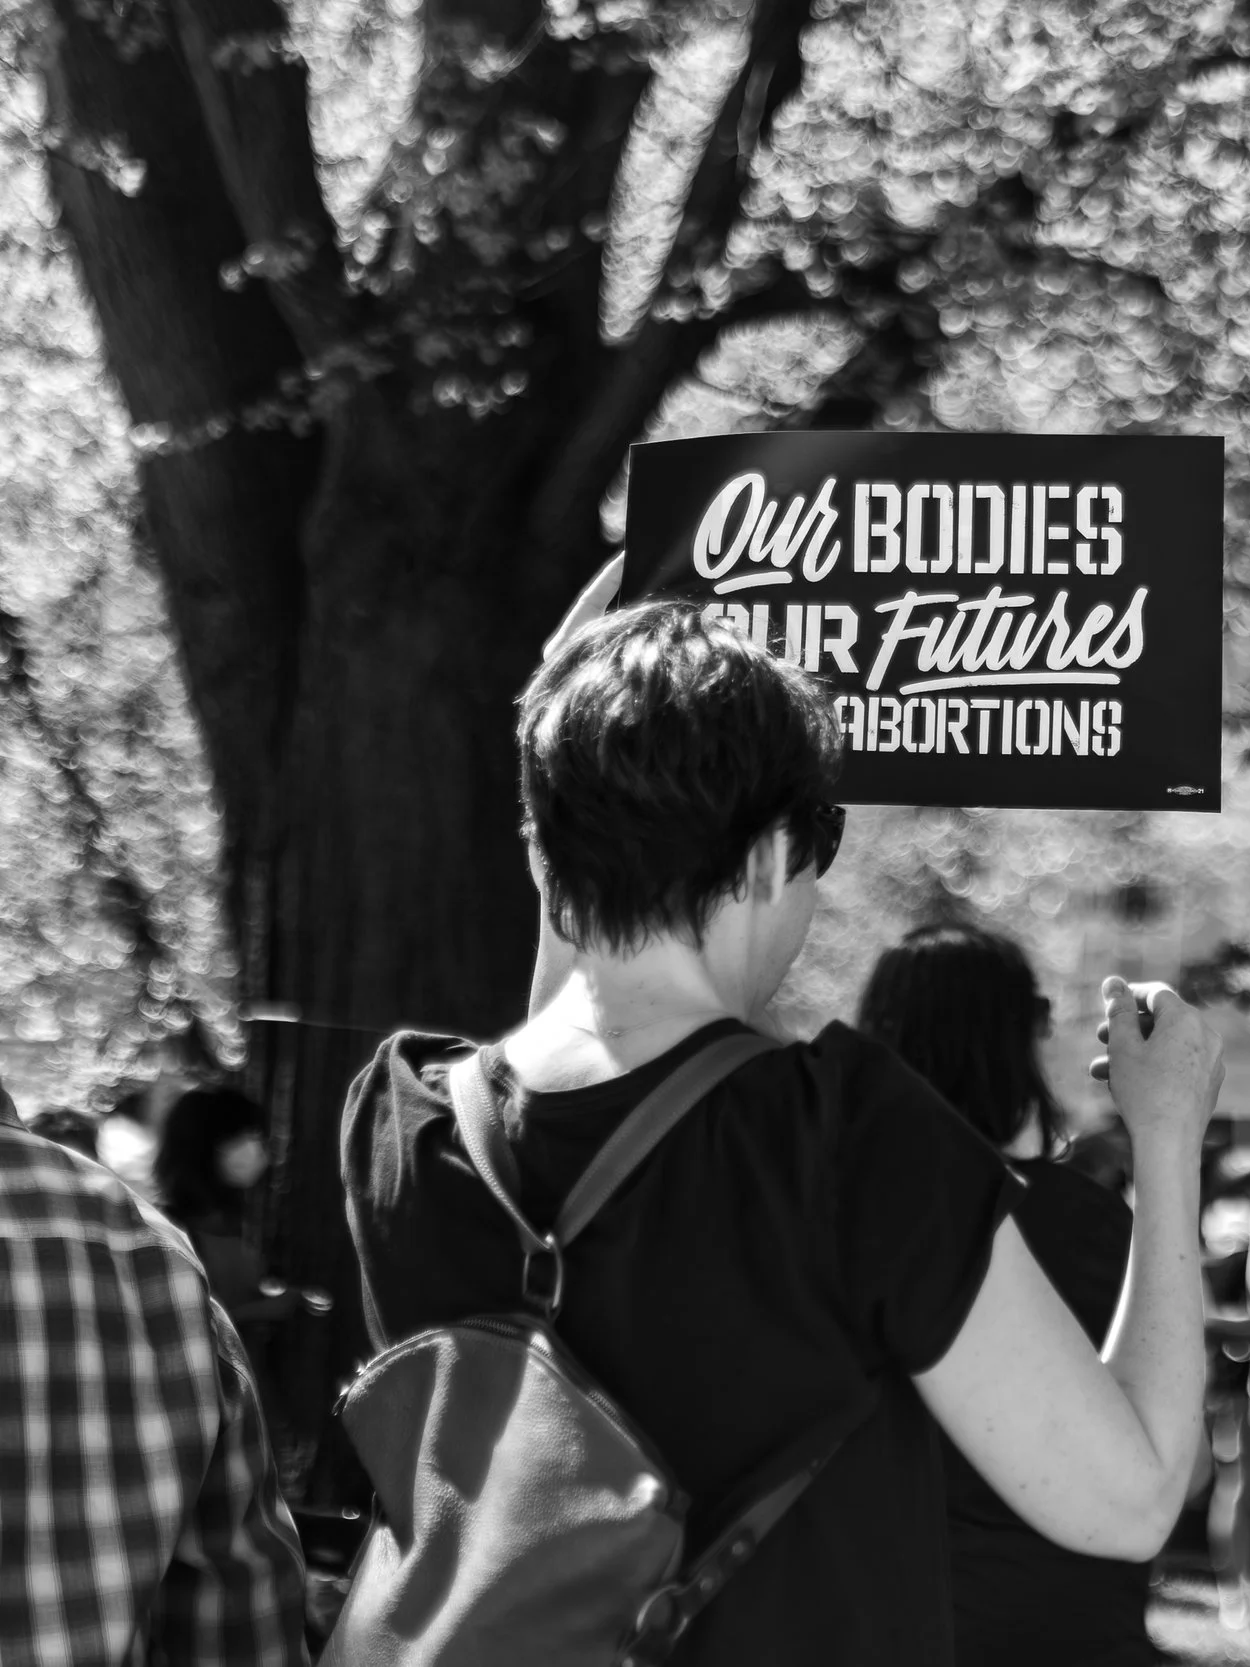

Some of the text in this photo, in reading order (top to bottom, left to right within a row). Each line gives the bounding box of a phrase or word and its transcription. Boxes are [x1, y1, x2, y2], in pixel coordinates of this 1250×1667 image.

[693, 472, 1123, 583] Our BODIES
[866, 586, 1148, 691] Futures
[833, 696, 1122, 756] ABORTIONS
